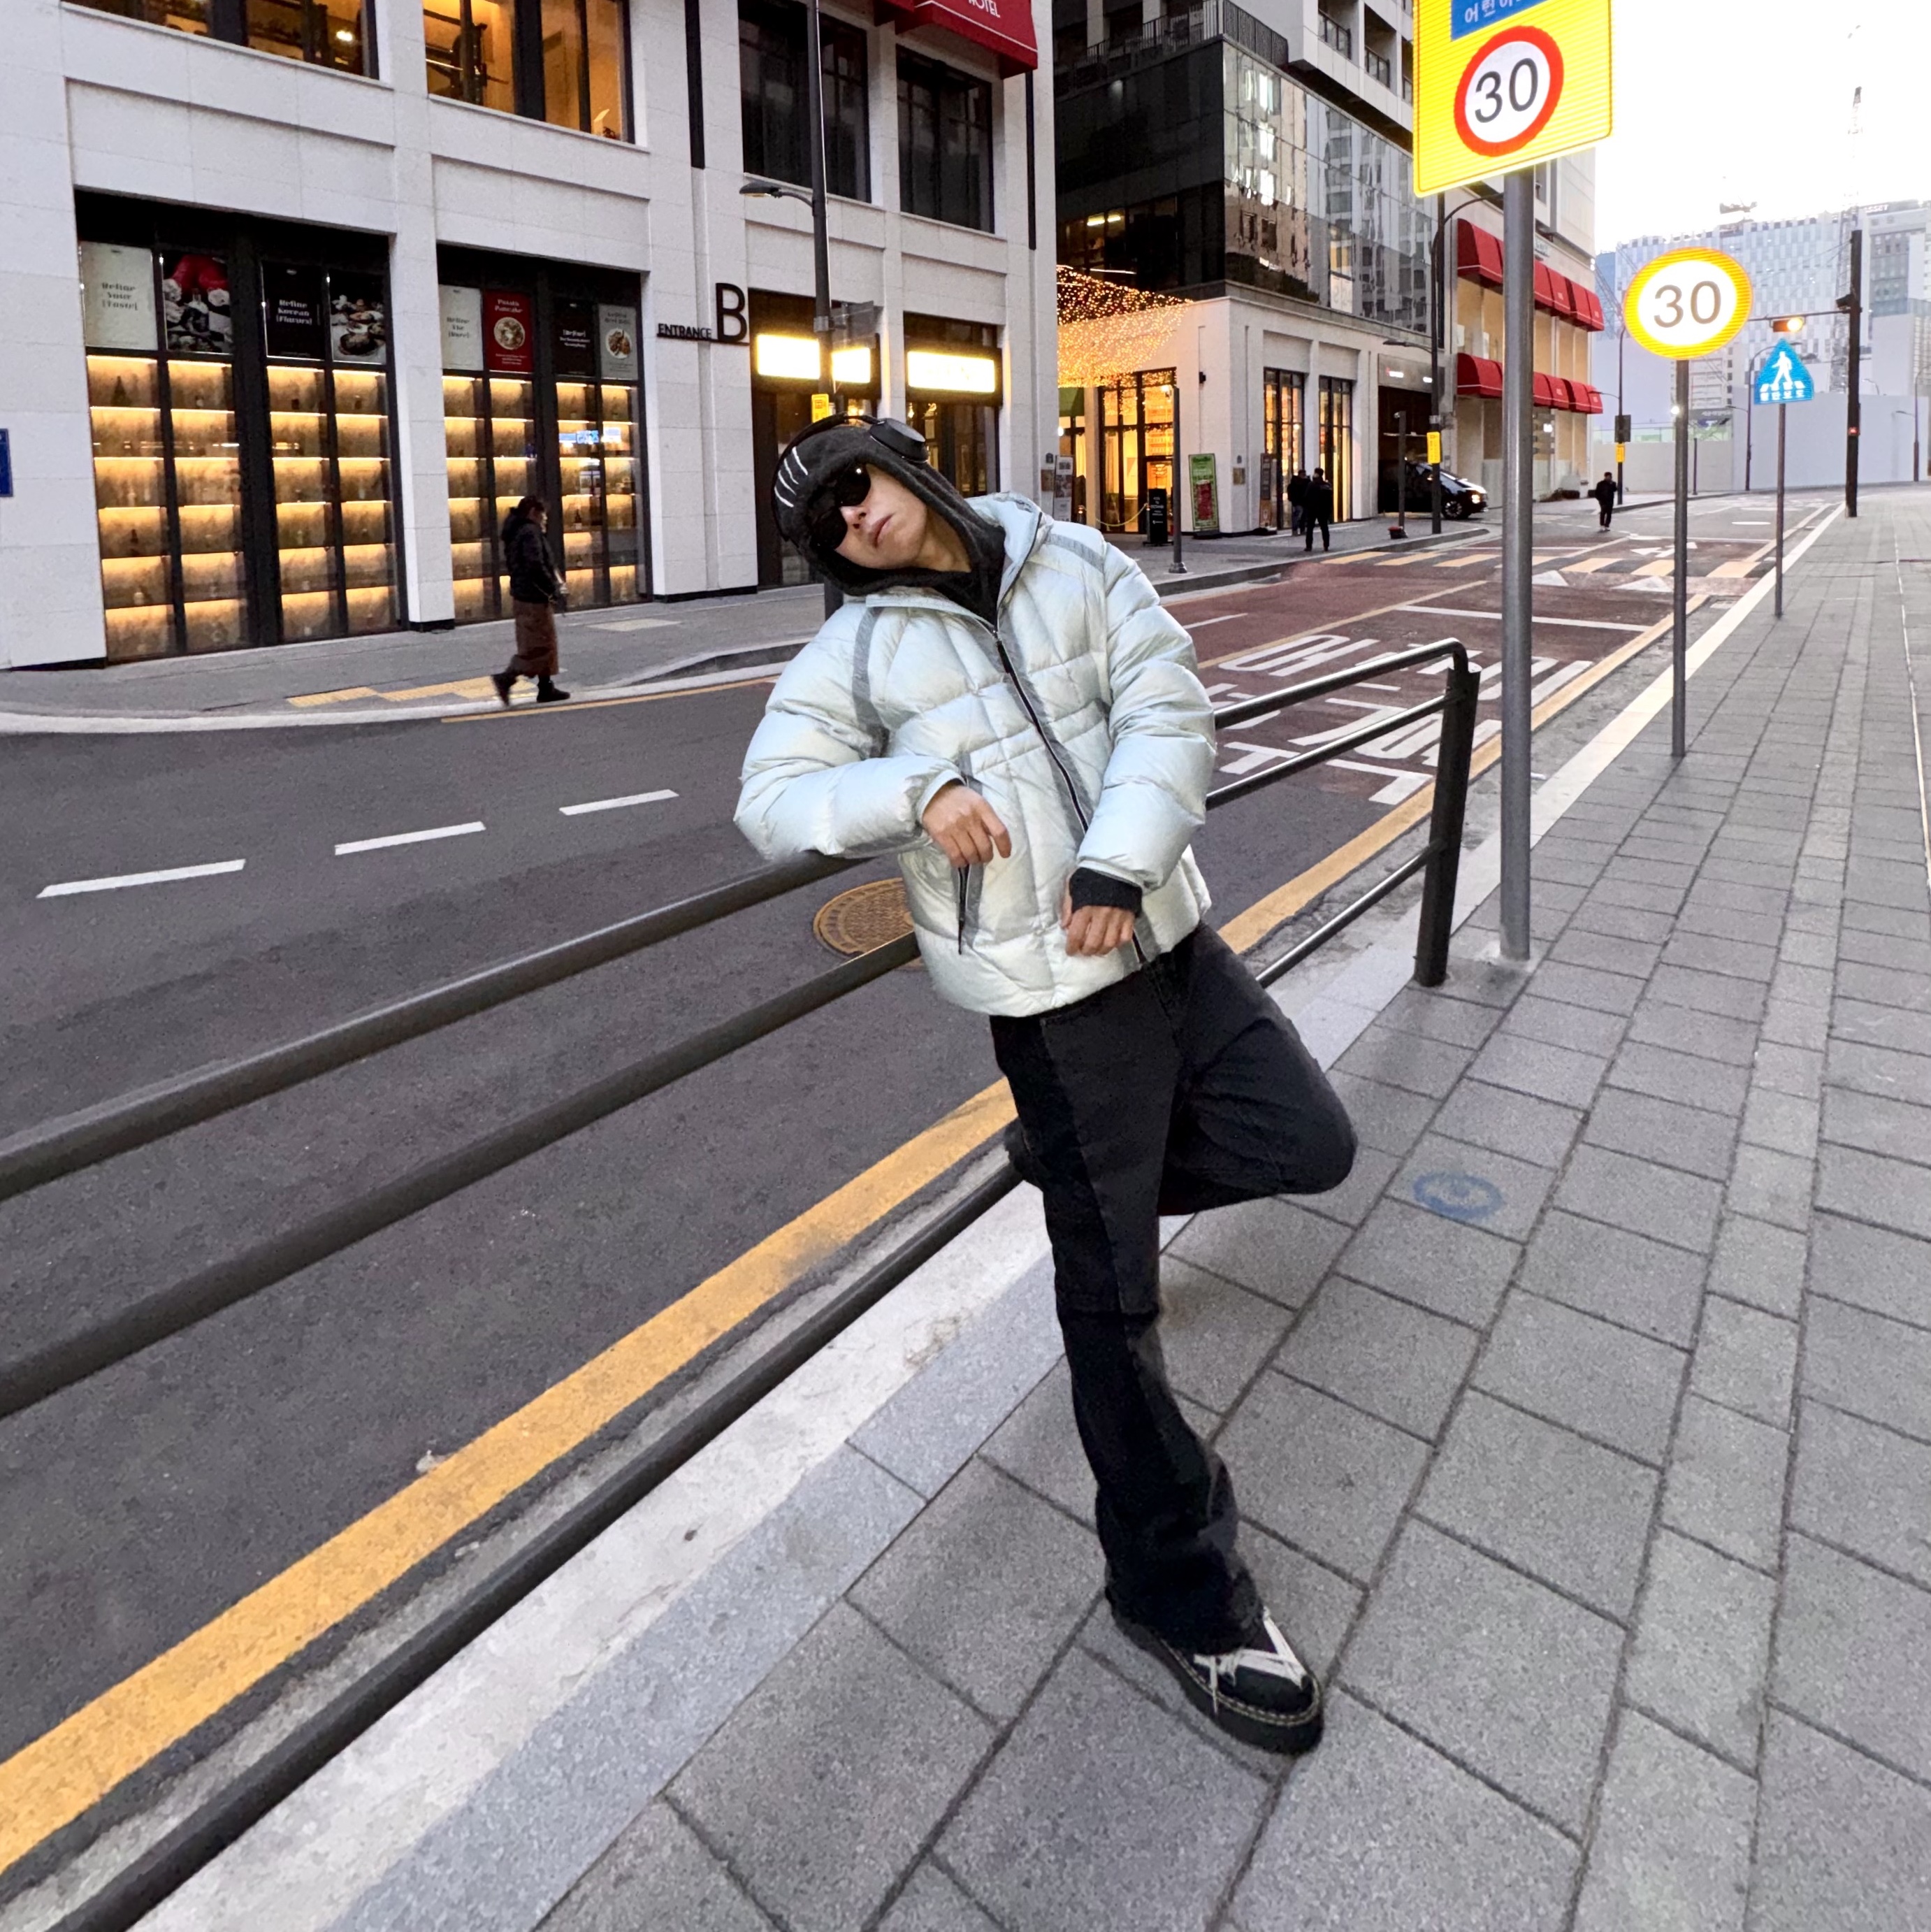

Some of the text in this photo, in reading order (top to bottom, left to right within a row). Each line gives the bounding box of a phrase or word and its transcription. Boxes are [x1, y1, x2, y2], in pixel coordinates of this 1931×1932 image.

[1475, 58, 1538, 123] 30
[658, 282, 747, 342] ENTRANCE B
[1654, 280, 1721, 328] 30
